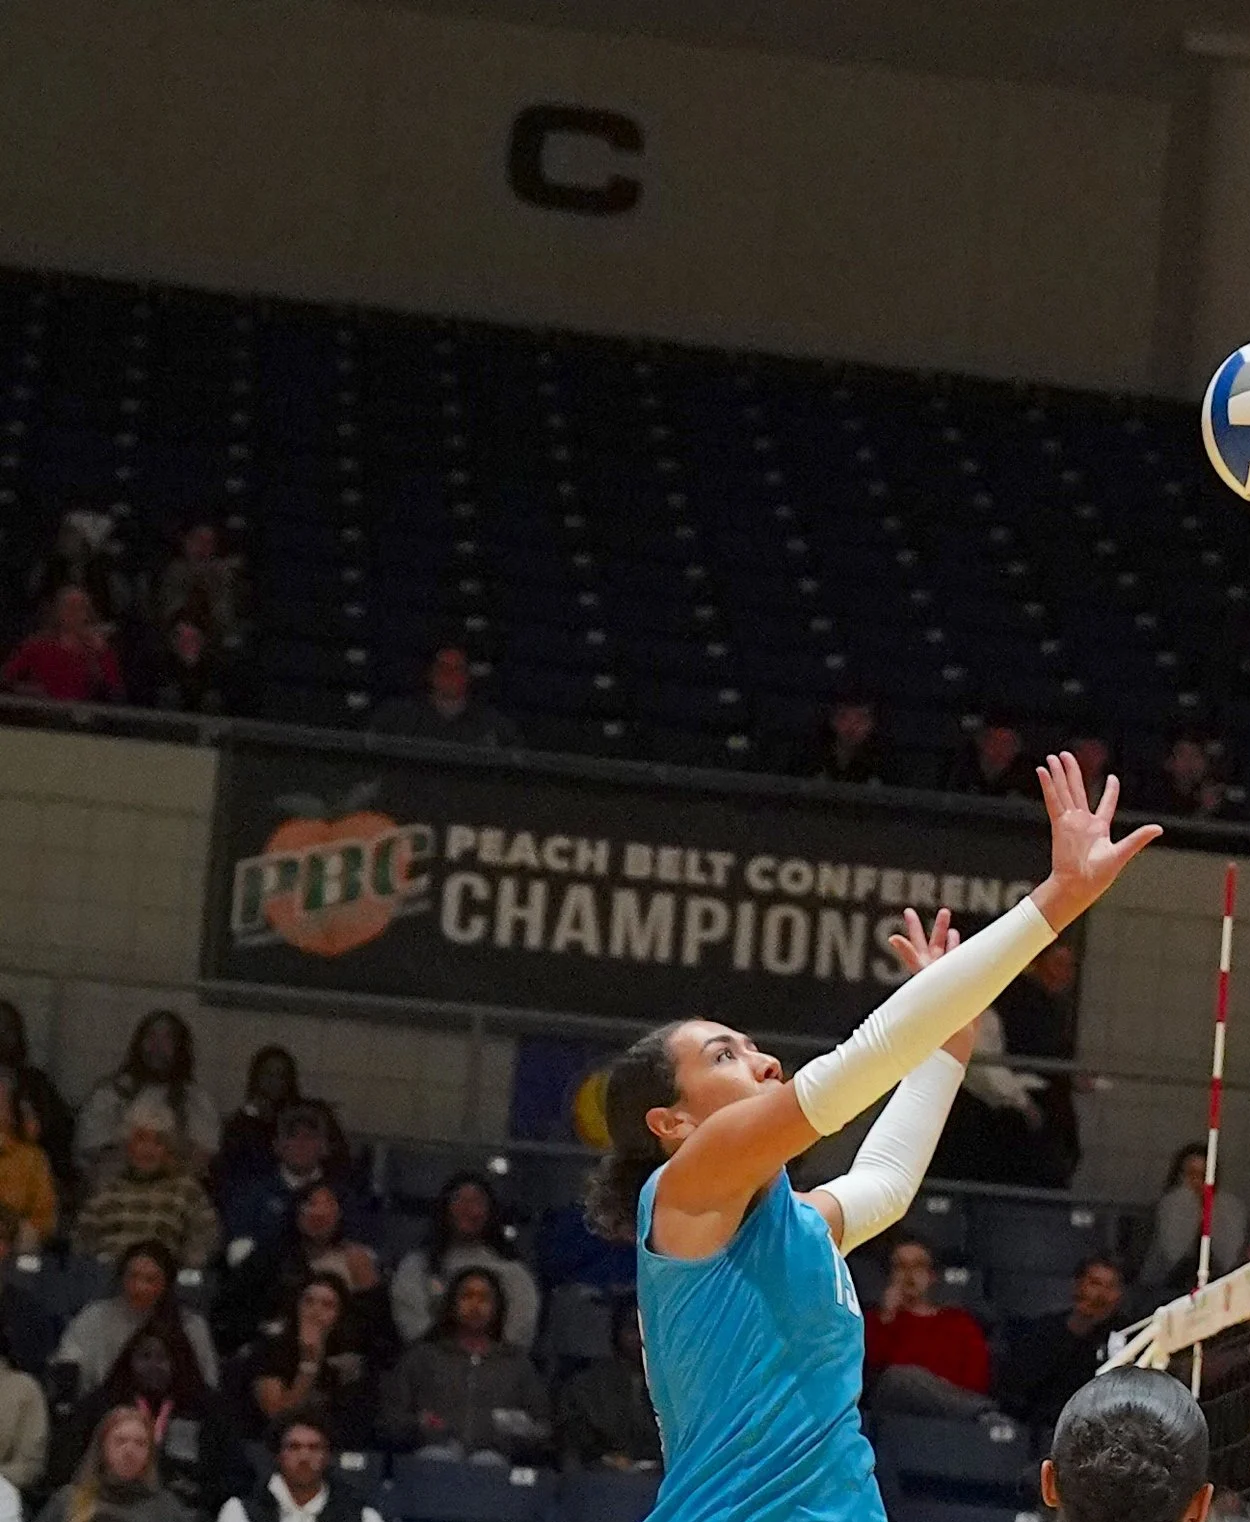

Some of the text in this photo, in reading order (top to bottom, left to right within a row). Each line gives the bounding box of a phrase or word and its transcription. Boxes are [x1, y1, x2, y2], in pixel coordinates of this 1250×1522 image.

[509, 105, 645, 213] C
[445, 825, 1036, 915] PEACH BELT CONFERENC
